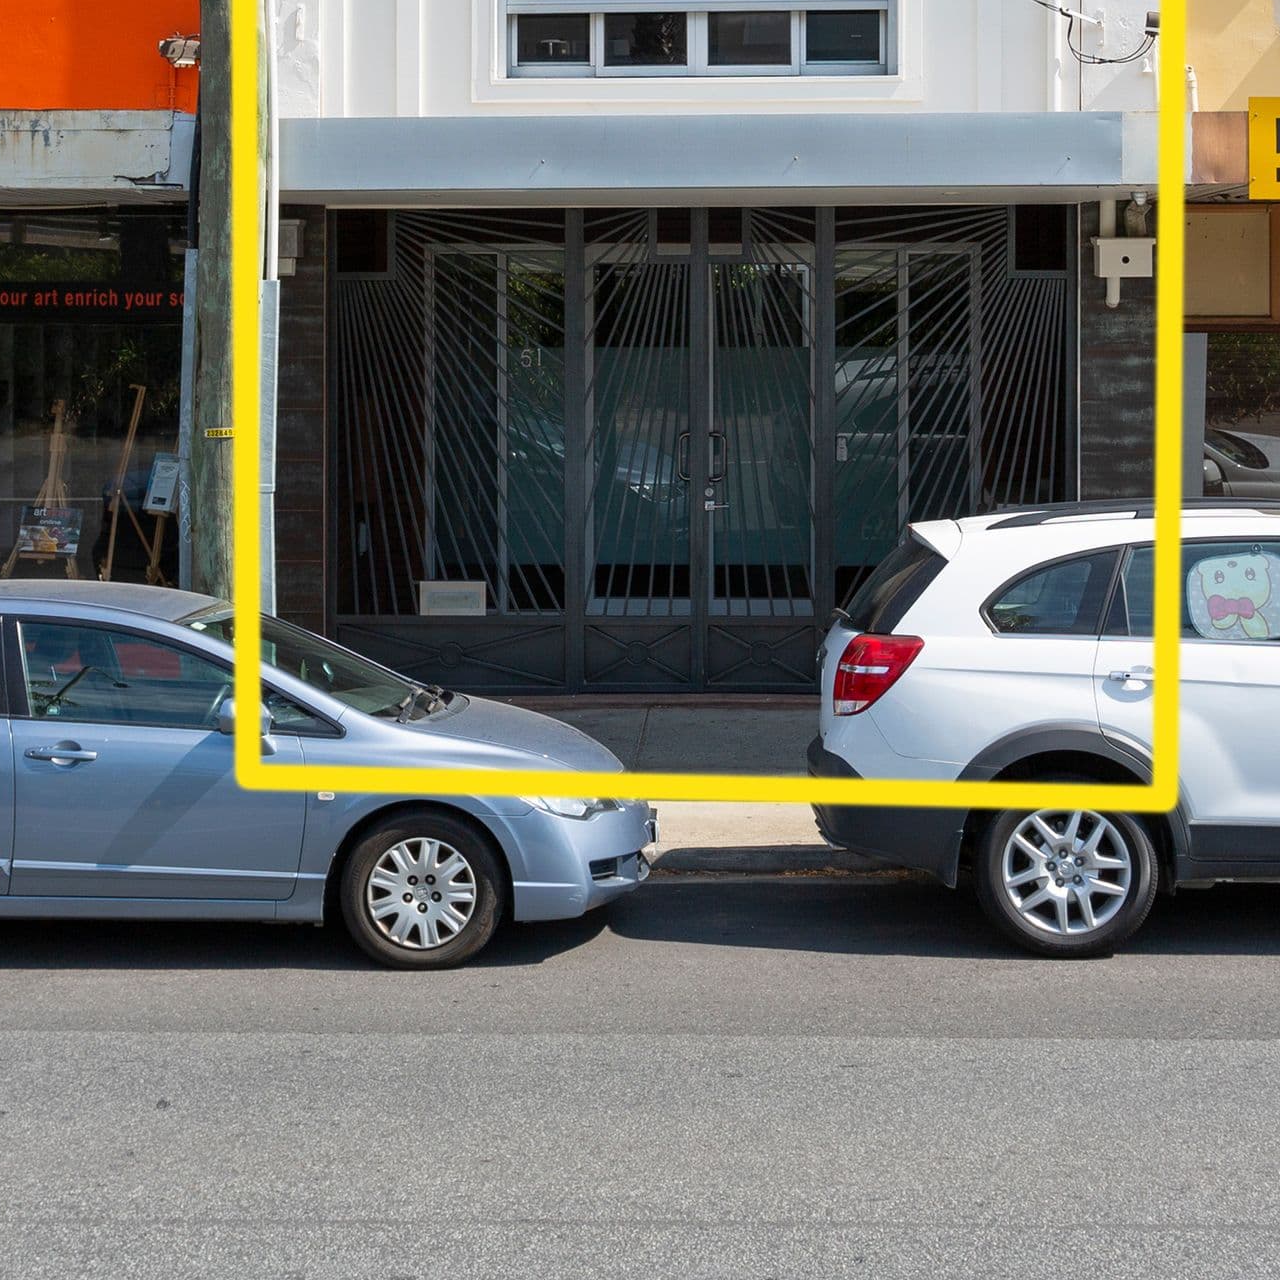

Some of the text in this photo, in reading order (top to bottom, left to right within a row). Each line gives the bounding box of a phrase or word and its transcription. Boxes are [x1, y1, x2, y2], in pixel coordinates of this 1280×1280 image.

[34, 289, 58, 306] art
[65, 288, 119, 306] enrich
[124, 290, 163, 310] your
[169, 291, 185, 306] so
[521, 348, 541, 368] 51
